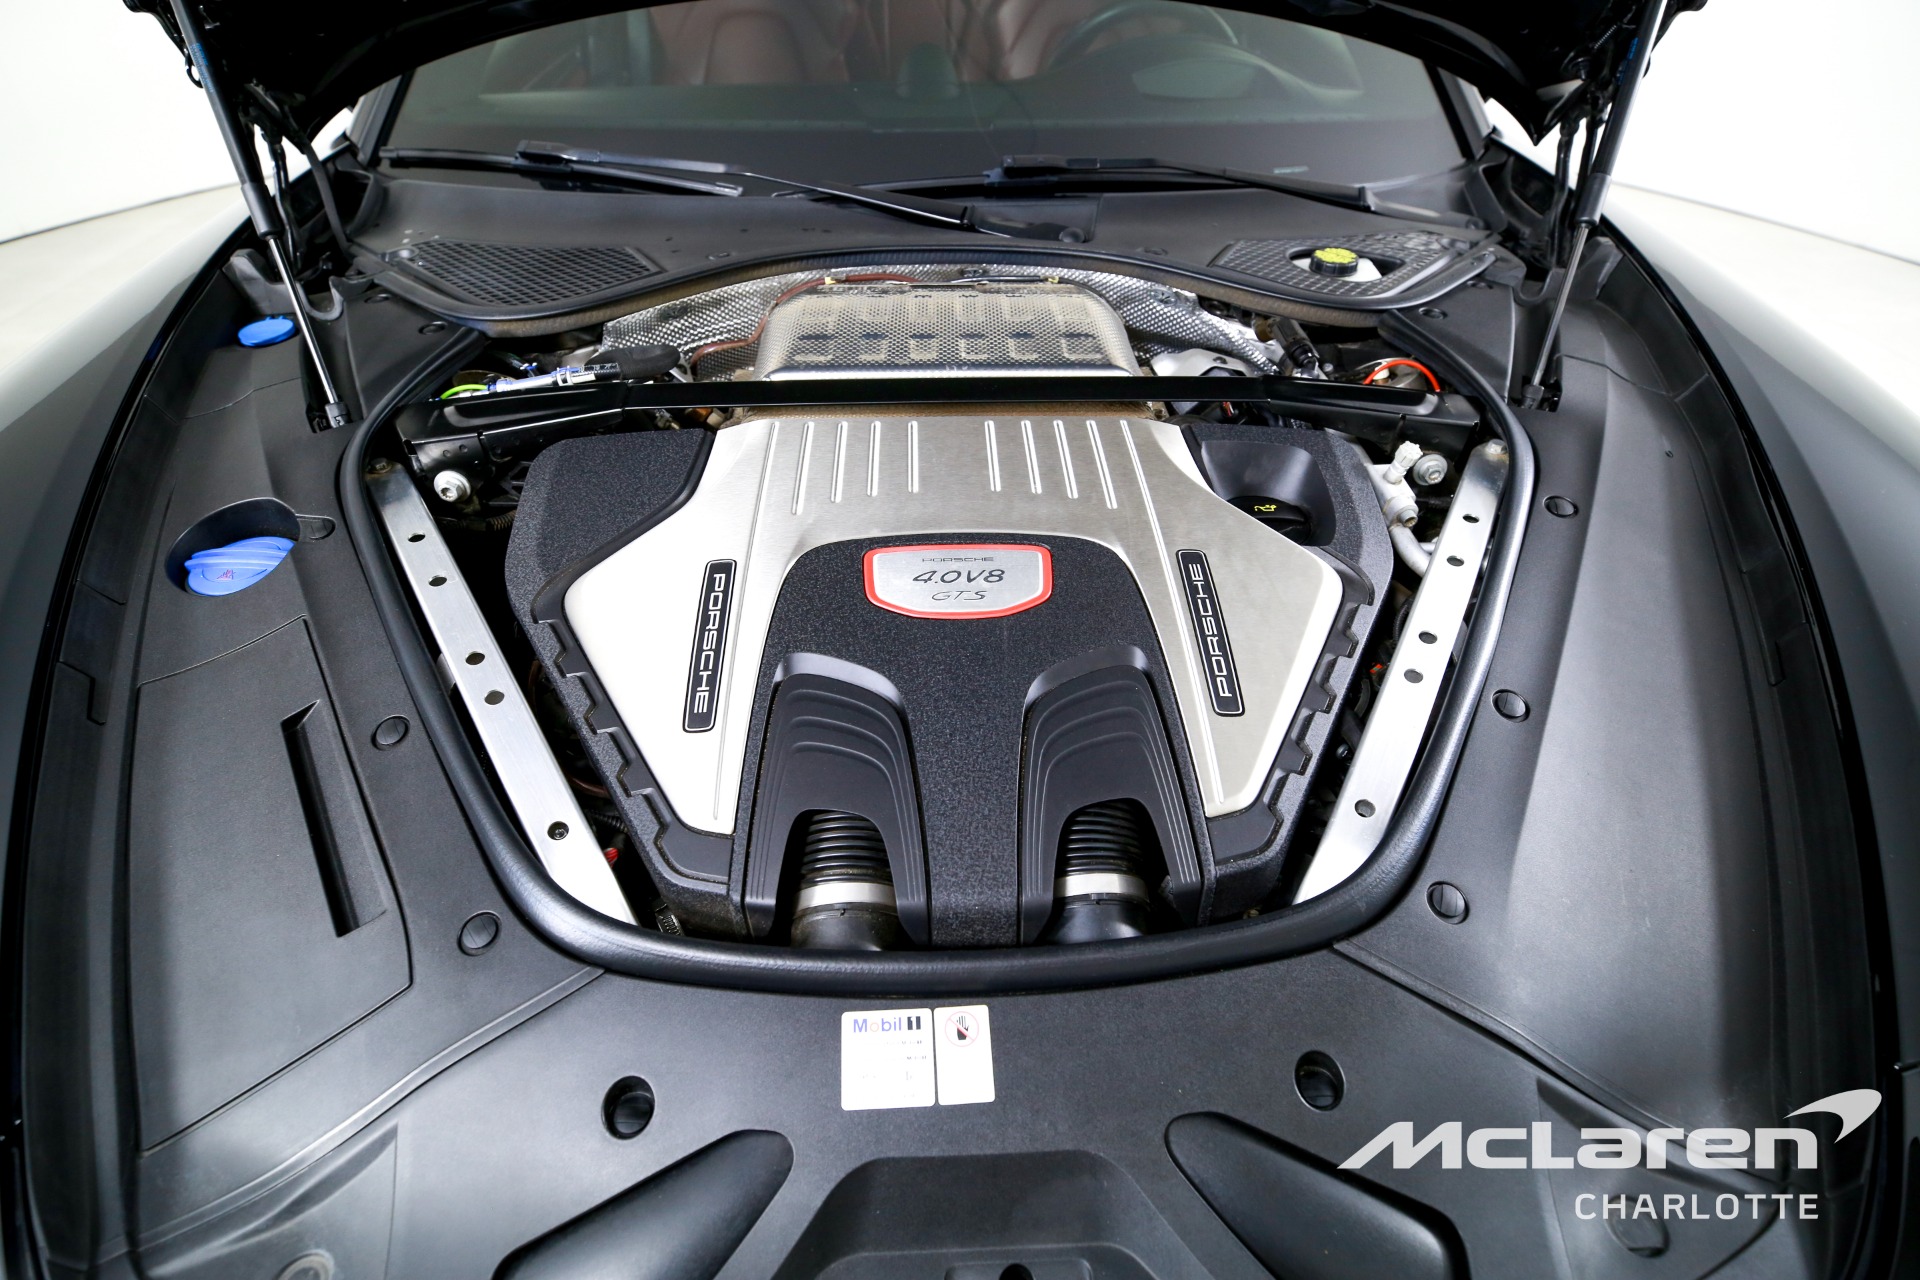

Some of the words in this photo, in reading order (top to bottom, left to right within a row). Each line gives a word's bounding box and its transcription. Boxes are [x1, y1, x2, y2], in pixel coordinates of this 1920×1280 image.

[931, 590, 987, 601] GTS
[1189, 563, 1232, 697] PORSCHE
[694, 573, 725, 713] PORSCHE
[853, 1017, 902, 1033] Mobil
